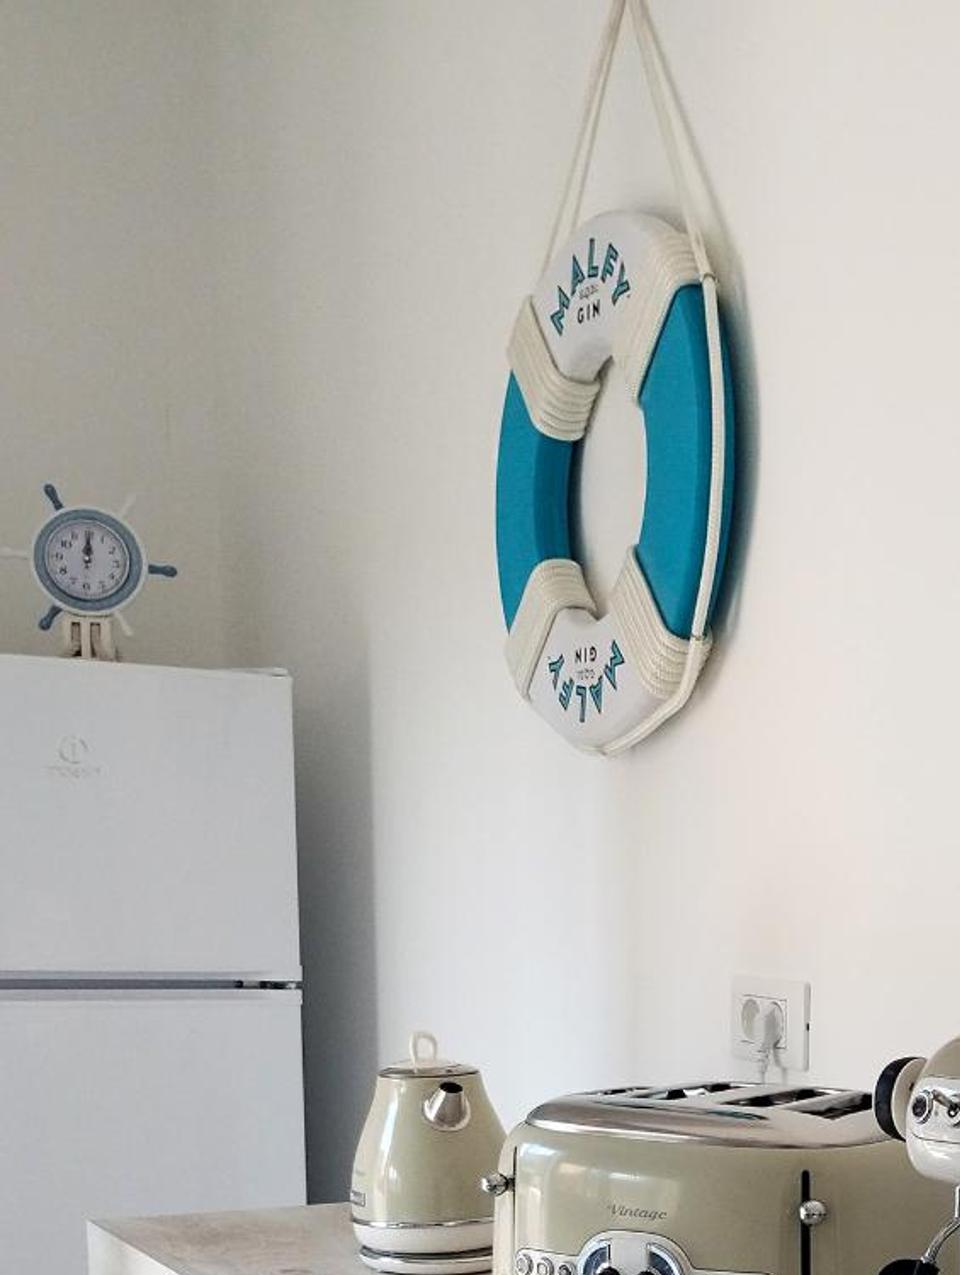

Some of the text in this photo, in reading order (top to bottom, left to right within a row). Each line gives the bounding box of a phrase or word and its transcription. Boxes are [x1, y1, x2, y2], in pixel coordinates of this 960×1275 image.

[550, 238, 631, 337] MALFY
[577, 300, 601, 324] GIN
[575, 646, 597, 662] GIN
[548, 639, 625, 723] MALFY
[607, 1203, 667, 1221] Vintage
